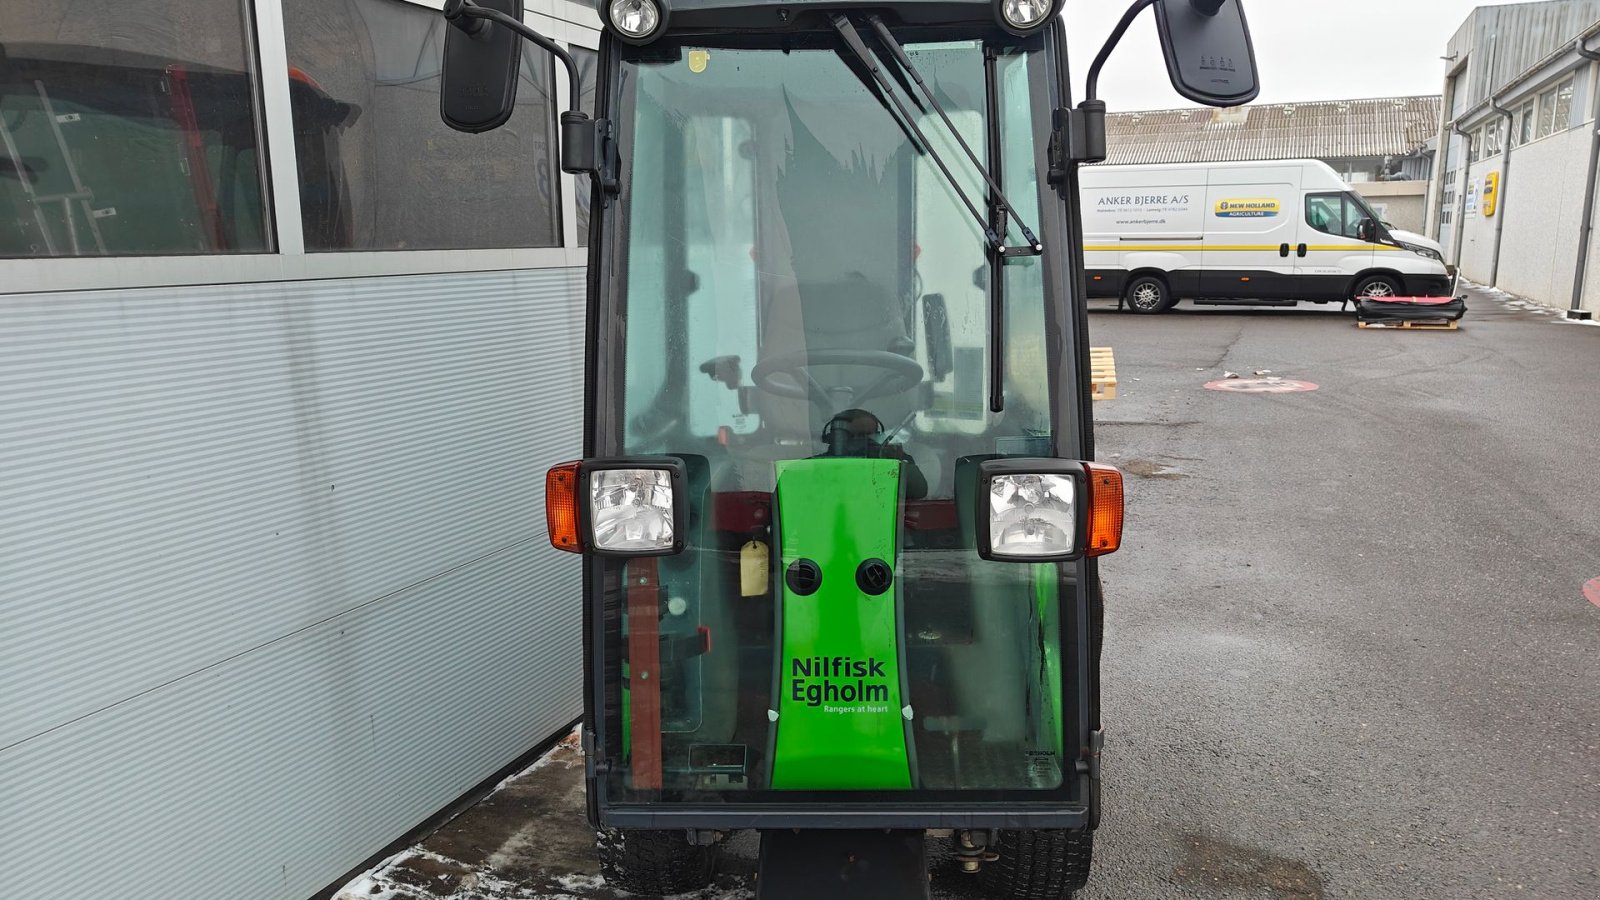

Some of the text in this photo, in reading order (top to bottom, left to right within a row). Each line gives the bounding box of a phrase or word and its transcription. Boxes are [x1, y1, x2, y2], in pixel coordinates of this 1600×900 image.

[1097, 194, 1189, 206] ANKER BJERRE A/S
[792, 656, 886, 677] Nilfisk
[792, 679, 888, 706] Egholm
[824, 705, 855, 714] Rangers
